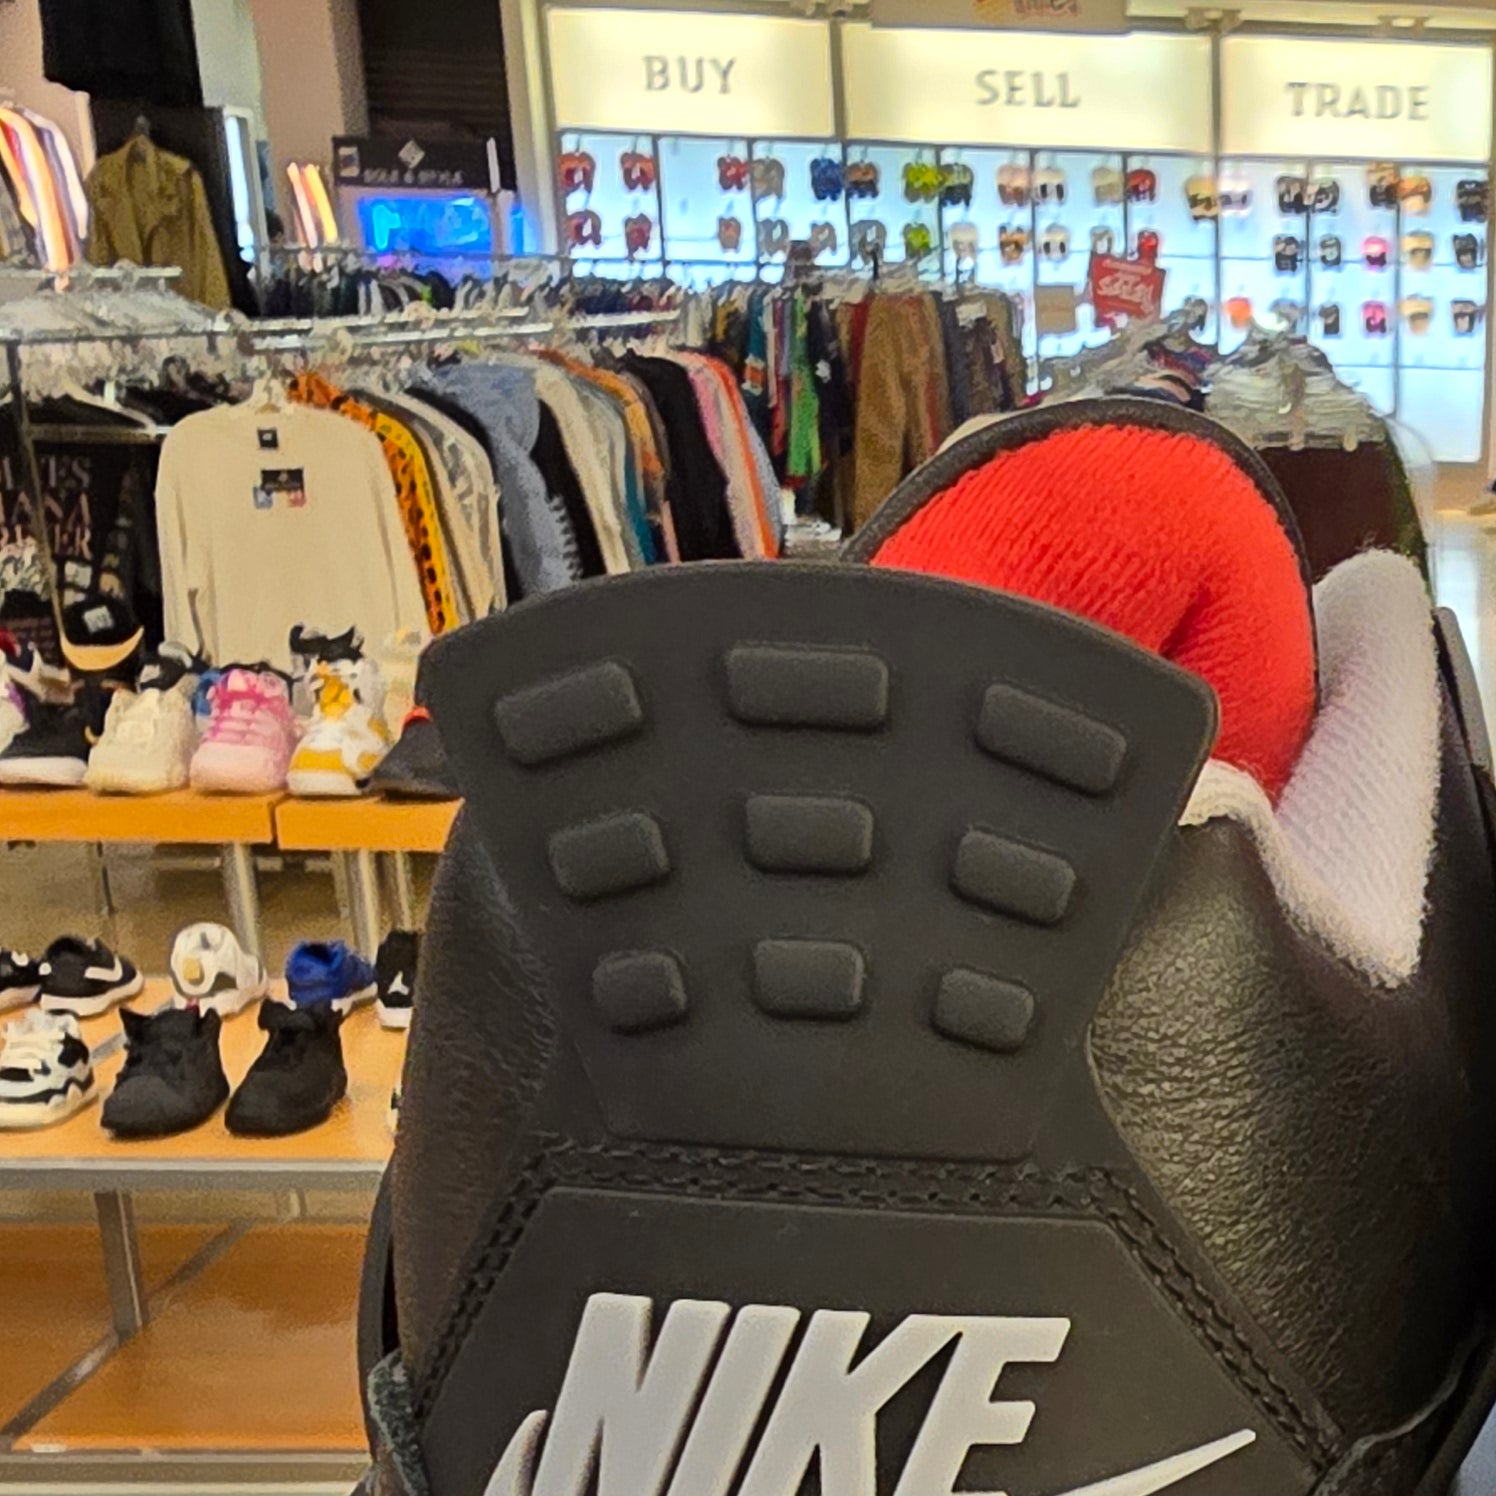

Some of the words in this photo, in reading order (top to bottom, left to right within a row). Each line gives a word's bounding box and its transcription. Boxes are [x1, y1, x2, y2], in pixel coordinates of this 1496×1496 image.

[643, 55, 737, 94] BUY
[975, 69, 1081, 109] SELL
[1285, 82, 1430, 120] TRADE
